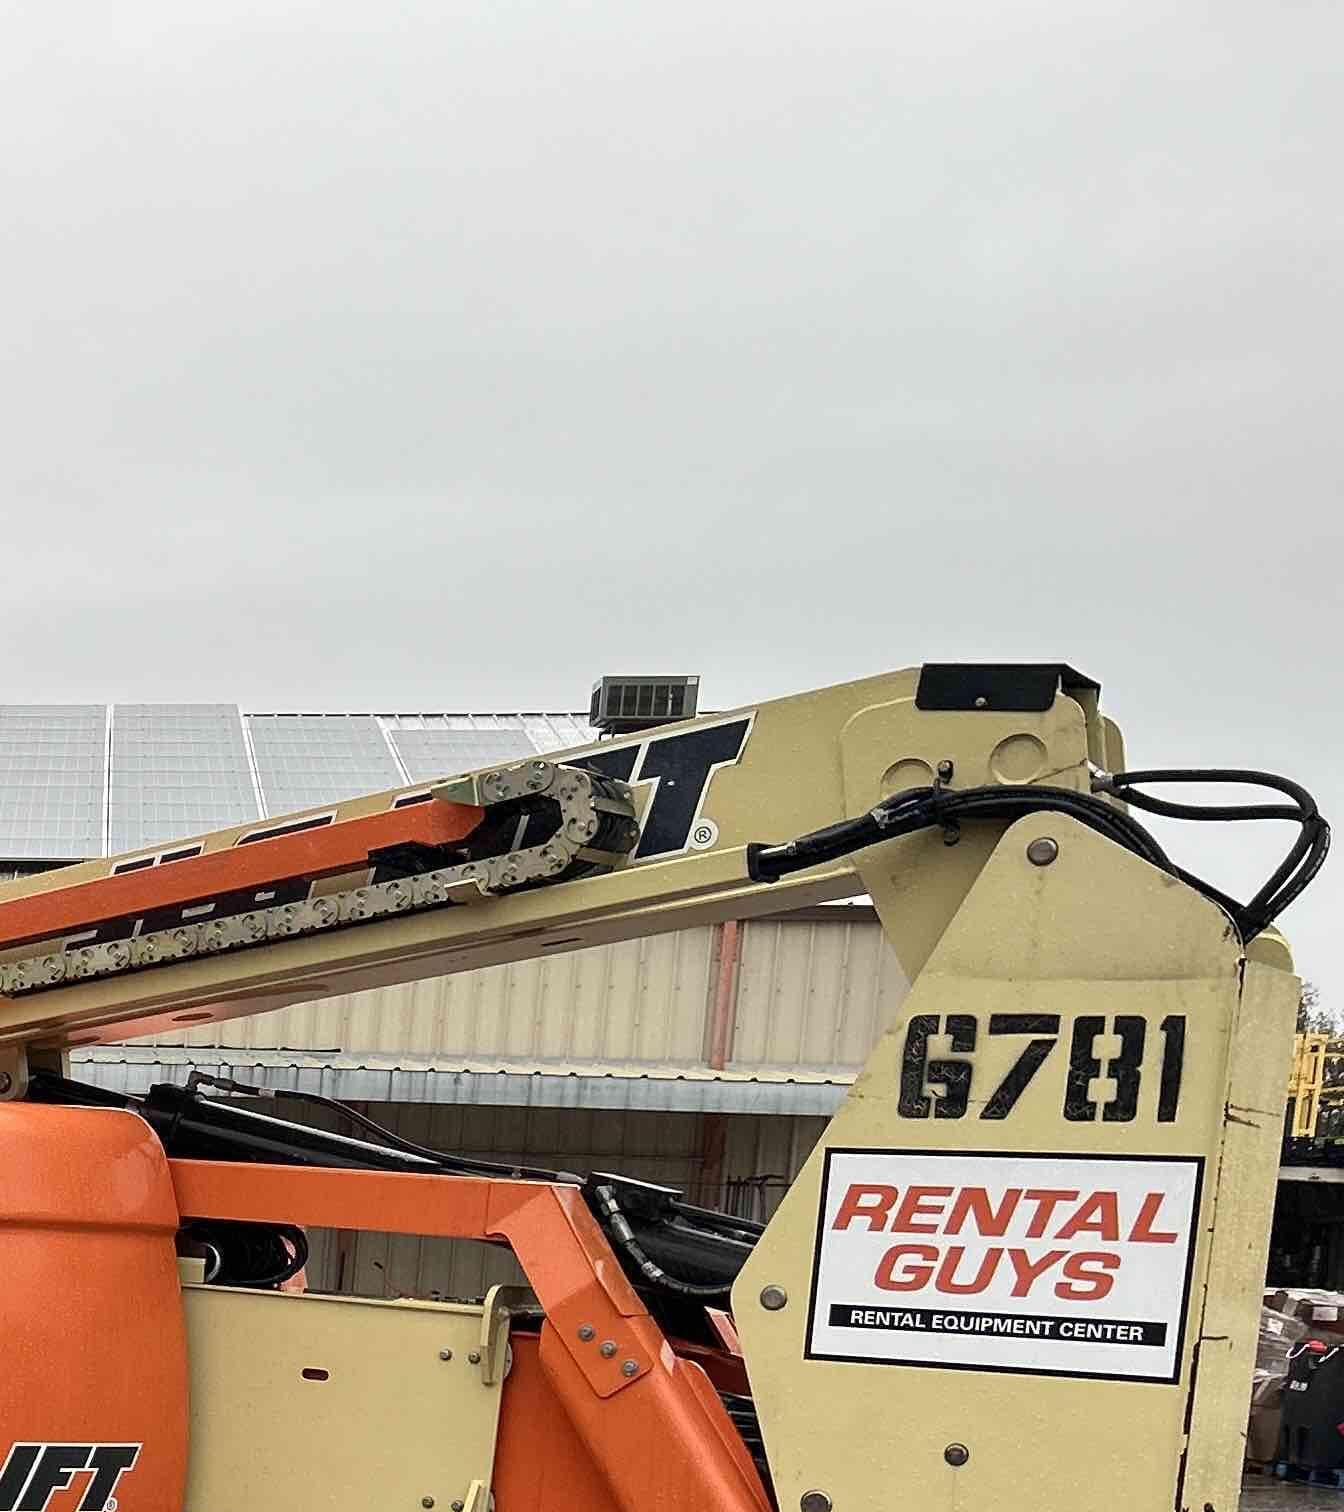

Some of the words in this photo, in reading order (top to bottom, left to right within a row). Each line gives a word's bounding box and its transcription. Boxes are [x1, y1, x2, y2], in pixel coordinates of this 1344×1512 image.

[897, 1013, 1187, 1123] 6781
[831, 1183, 1179, 1244] RENTAL
[874, 1243, 1122, 1301] GUYS
[850, 1309, 926, 1330] RENTAL
[931, 1313, 1059, 1336] EQUIPMENT
[1059, 1322, 1144, 1341] CENTER
